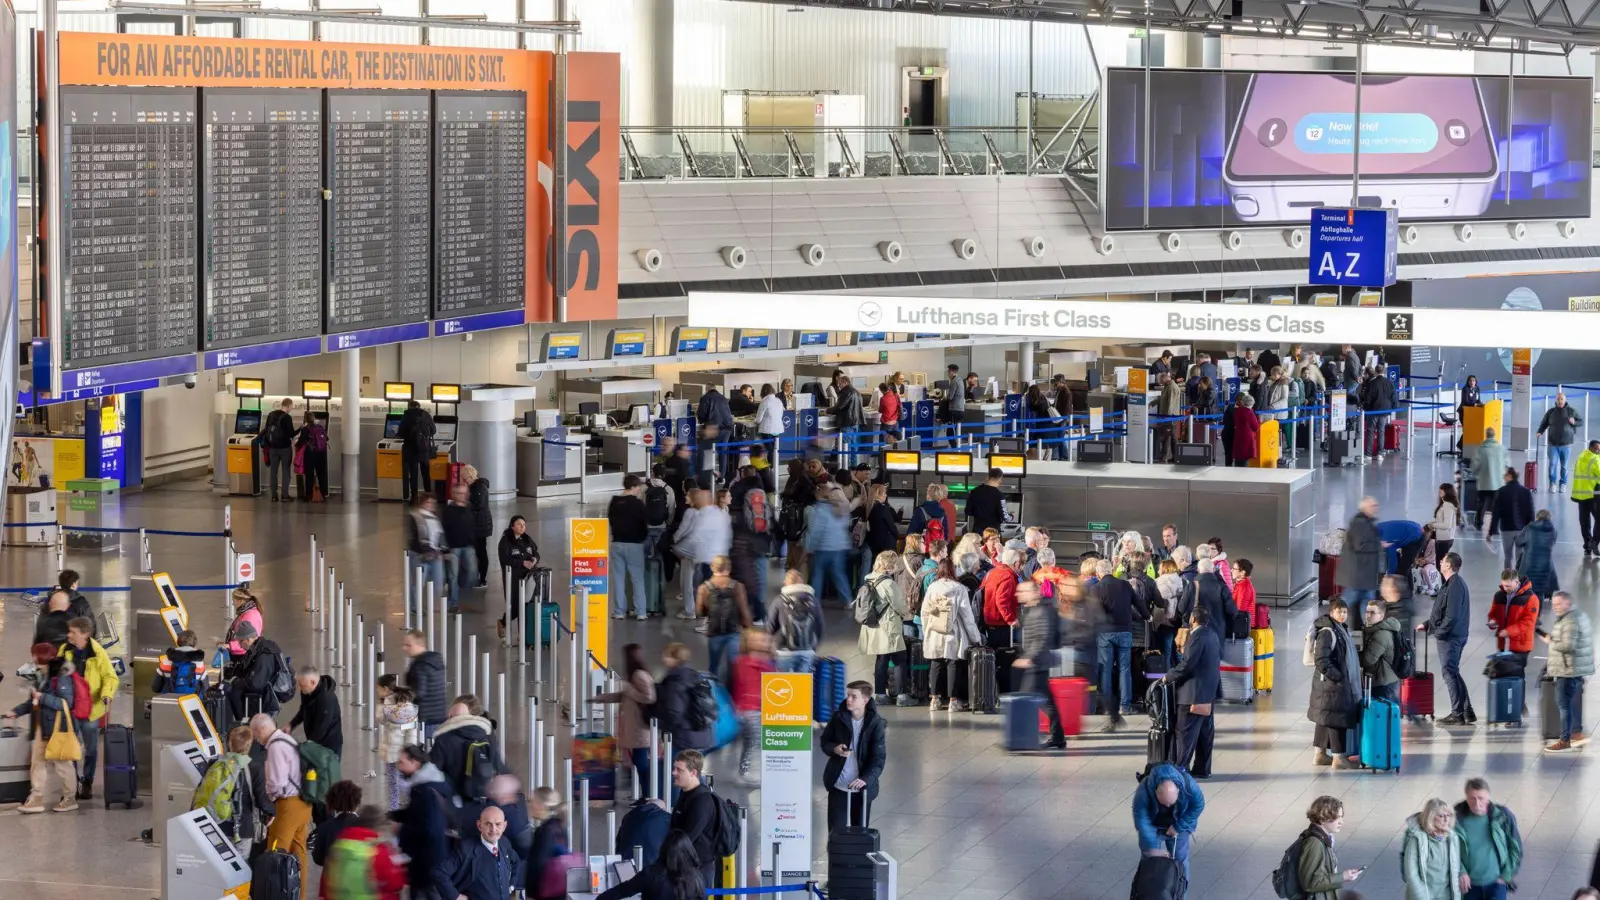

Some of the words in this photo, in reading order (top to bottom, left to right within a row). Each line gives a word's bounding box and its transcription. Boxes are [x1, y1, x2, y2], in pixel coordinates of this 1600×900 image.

[97, 42, 131, 77] FOR
[135, 42, 158, 77] AN
[162, 44, 261, 79] AFFORDABLE
[265, 48, 317, 80] RENTAL
[321, 50, 352, 86] CAR,
[355, 51, 380, 81] THE
[383, 52, 461, 83] DESTINATION
[465, 54, 475, 83] IS
[478, 54, 506, 84] SIXT.
[1328, 121, 1353, 132] Now
[1327, 137, 1352, 145] Heute
[1321, 214, 1346, 222] Terminal
[1320, 226, 1354, 235] Abflughalle
[1320, 234, 1351, 243] Departures
[1352, 235, 1364, 243] hall
[1318, 251, 1361, 280] A,Z
[897, 305, 998, 327] Lufthansa
[1004, 307, 1049, 328] First
[1053, 309, 1111, 330] Class
[1167, 312, 1261, 332] Business
[1266, 314, 1325, 335] Class
[574, 547, 606, 555] Lufthansa
[765, 712, 808, 721] Lufthansa
[765, 729, 804, 739] Economy
[765, 738, 789, 746] Class
